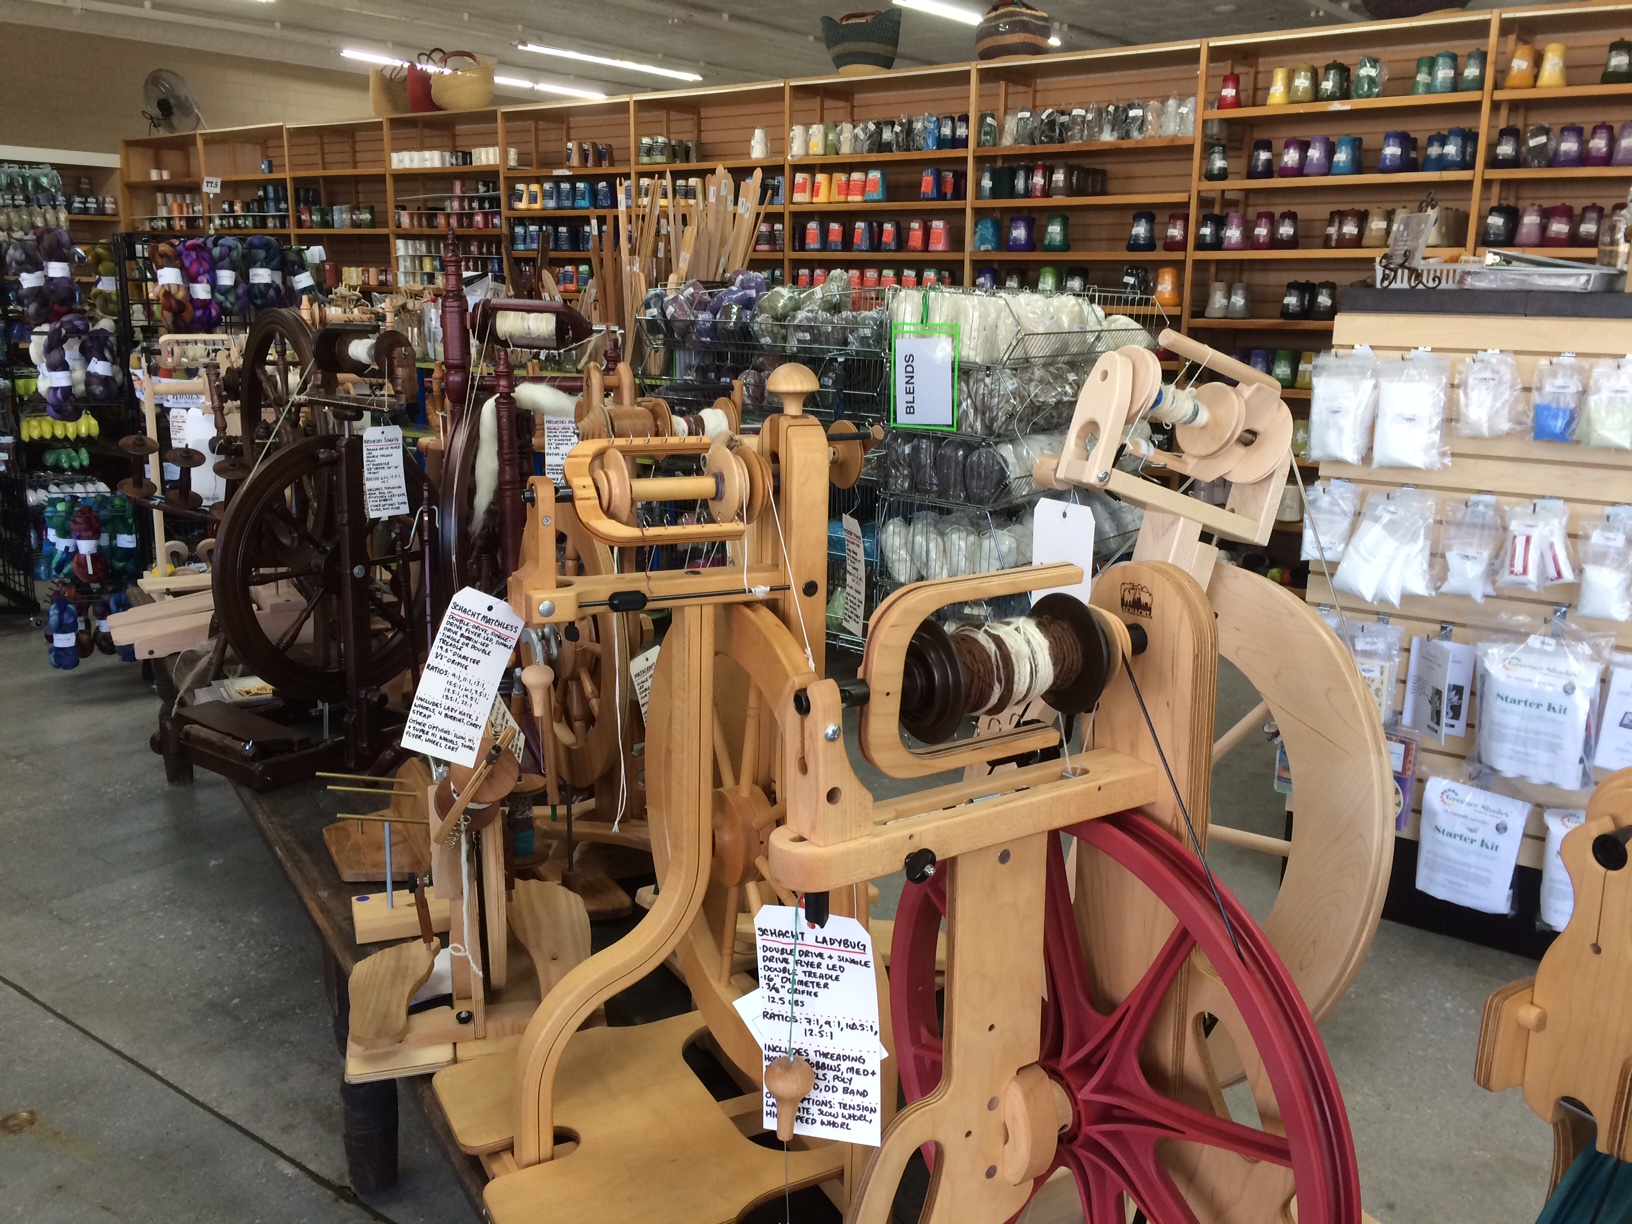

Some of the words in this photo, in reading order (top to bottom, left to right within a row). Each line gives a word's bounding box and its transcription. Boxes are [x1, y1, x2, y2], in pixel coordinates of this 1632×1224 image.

[904, 354, 915, 415] BLENDS
[451, 601, 481, 620] SCHACHT
[480, 614, 519, 633] MATCHLESS
[1122, 605, 1151, 619] SCHACHT
[446, 620, 463, 631] DRIVE
[439, 638, 464, 651] TREADLE
[442, 632, 460, 644] SINGLE
[471, 644, 492, 656] DOUBLE
[447, 657, 469, 671] ORIFICE
[452, 651, 481, 665] DIAMETER
[426, 663, 450, 678] RATIOS:
[416, 695, 442, 708] INCLUDES
[443, 704, 457, 714] LAZY
[458, 710, 474, 721] KATE,
[1496, 692, 1543, 710] Starter
[1547, 702, 1568, 716] Kit
[412, 709, 432, 720] STRAP
[443, 712, 466, 726] BOBBINS,
[409, 718, 427, 728] OTHER
[412, 726, 430, 736] SUPER
[406, 731, 424, 742] FLYER,
[424, 737, 443, 749] WHEEL
[1434, 825, 1477, 846] Starter
[1480, 839, 1500, 853] Kit
[757, 927, 806, 941] SCHACHT
[815, 935, 867, 953] LADYBUG
[762, 944, 795, 957] DOUBLE
[798, 949, 825, 960] DRIVE
[837, 955, 871, 968] SINGLE
[762, 955, 790, 965] DRIVE
[795, 959, 823, 970] FLYER
[827, 964, 846, 974] LED
[763, 964, 798, 977] DOUBLE
[802, 970, 841, 982] TREADLE
[764, 974, 780, 982] 16"
[787, 987, 819, 998] ORIFICE
[767, 994, 786, 1005] 12.5
[788, 999, 805, 1008] LBS
[762, 1010, 802, 1024] RATIOS:
[804, 1017, 824, 1029] 7:1,
[824, 1020, 844, 1032] 9:1,
[804, 1028, 834, 1040] 12.5:1
[764, 1043, 809, 1057] INCLUDES
[814, 1050, 866, 1065] THREADING
[833, 1074, 853, 1085] POLY
[842, 1086, 869, 1098] BAND
[838, 1101, 877, 1114] TENSION
[818, 1108, 839, 1119] SLOW
[841, 1112, 873, 1124] WHORL,
[820, 1119, 852, 1131] WHORL
